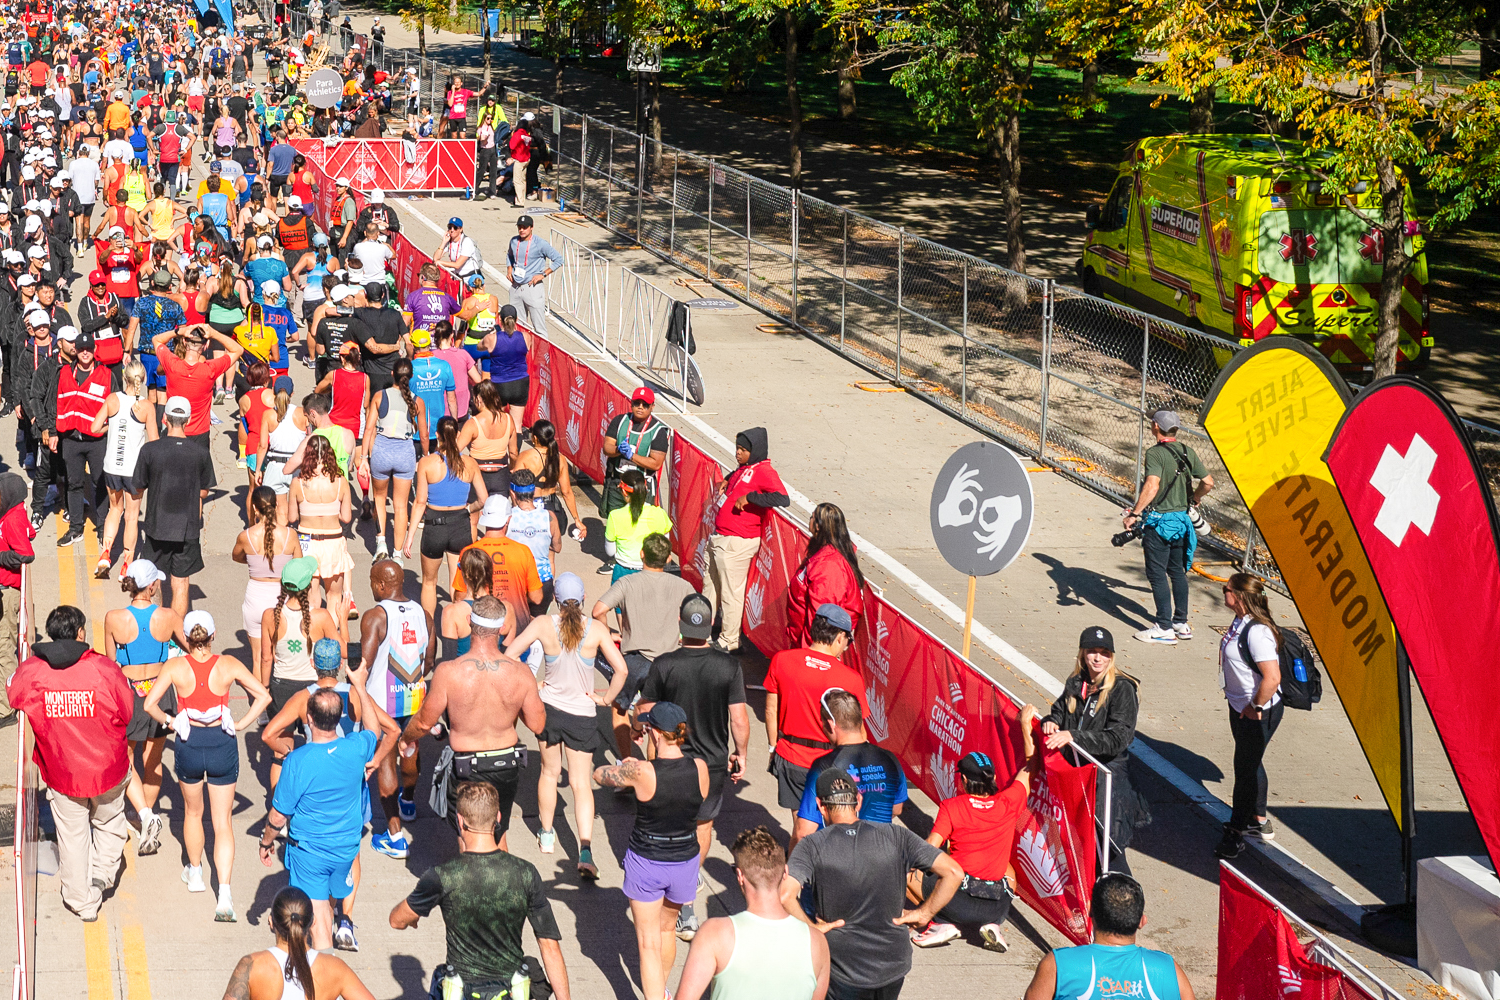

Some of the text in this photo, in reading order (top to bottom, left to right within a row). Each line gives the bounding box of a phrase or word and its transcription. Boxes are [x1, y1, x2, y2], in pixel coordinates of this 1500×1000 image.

[633, 51, 656, 66] 30
[316, 79, 333, 88] Para
[308, 86, 341, 97] Athletics
[1151, 207, 1200, 236] SUPERIOR
[118, 418, 128, 433] ONE
[116, 435, 127, 467] RUNNING
[867, 642, 890, 675] CHICAGO
[866, 657, 888, 687] MARATHON
[390, 682, 426, 693] RUN PROU
[44, 691, 94, 704] MONTERREY
[45, 704, 95, 717] SECURITY
[950, 708, 967, 726] AMERICA
[931, 704, 965, 742] CHICAGO
[928, 720, 962, 756] MARATHON
[860, 764, 884, 774] autism
[862, 773, 887, 782] speaks
